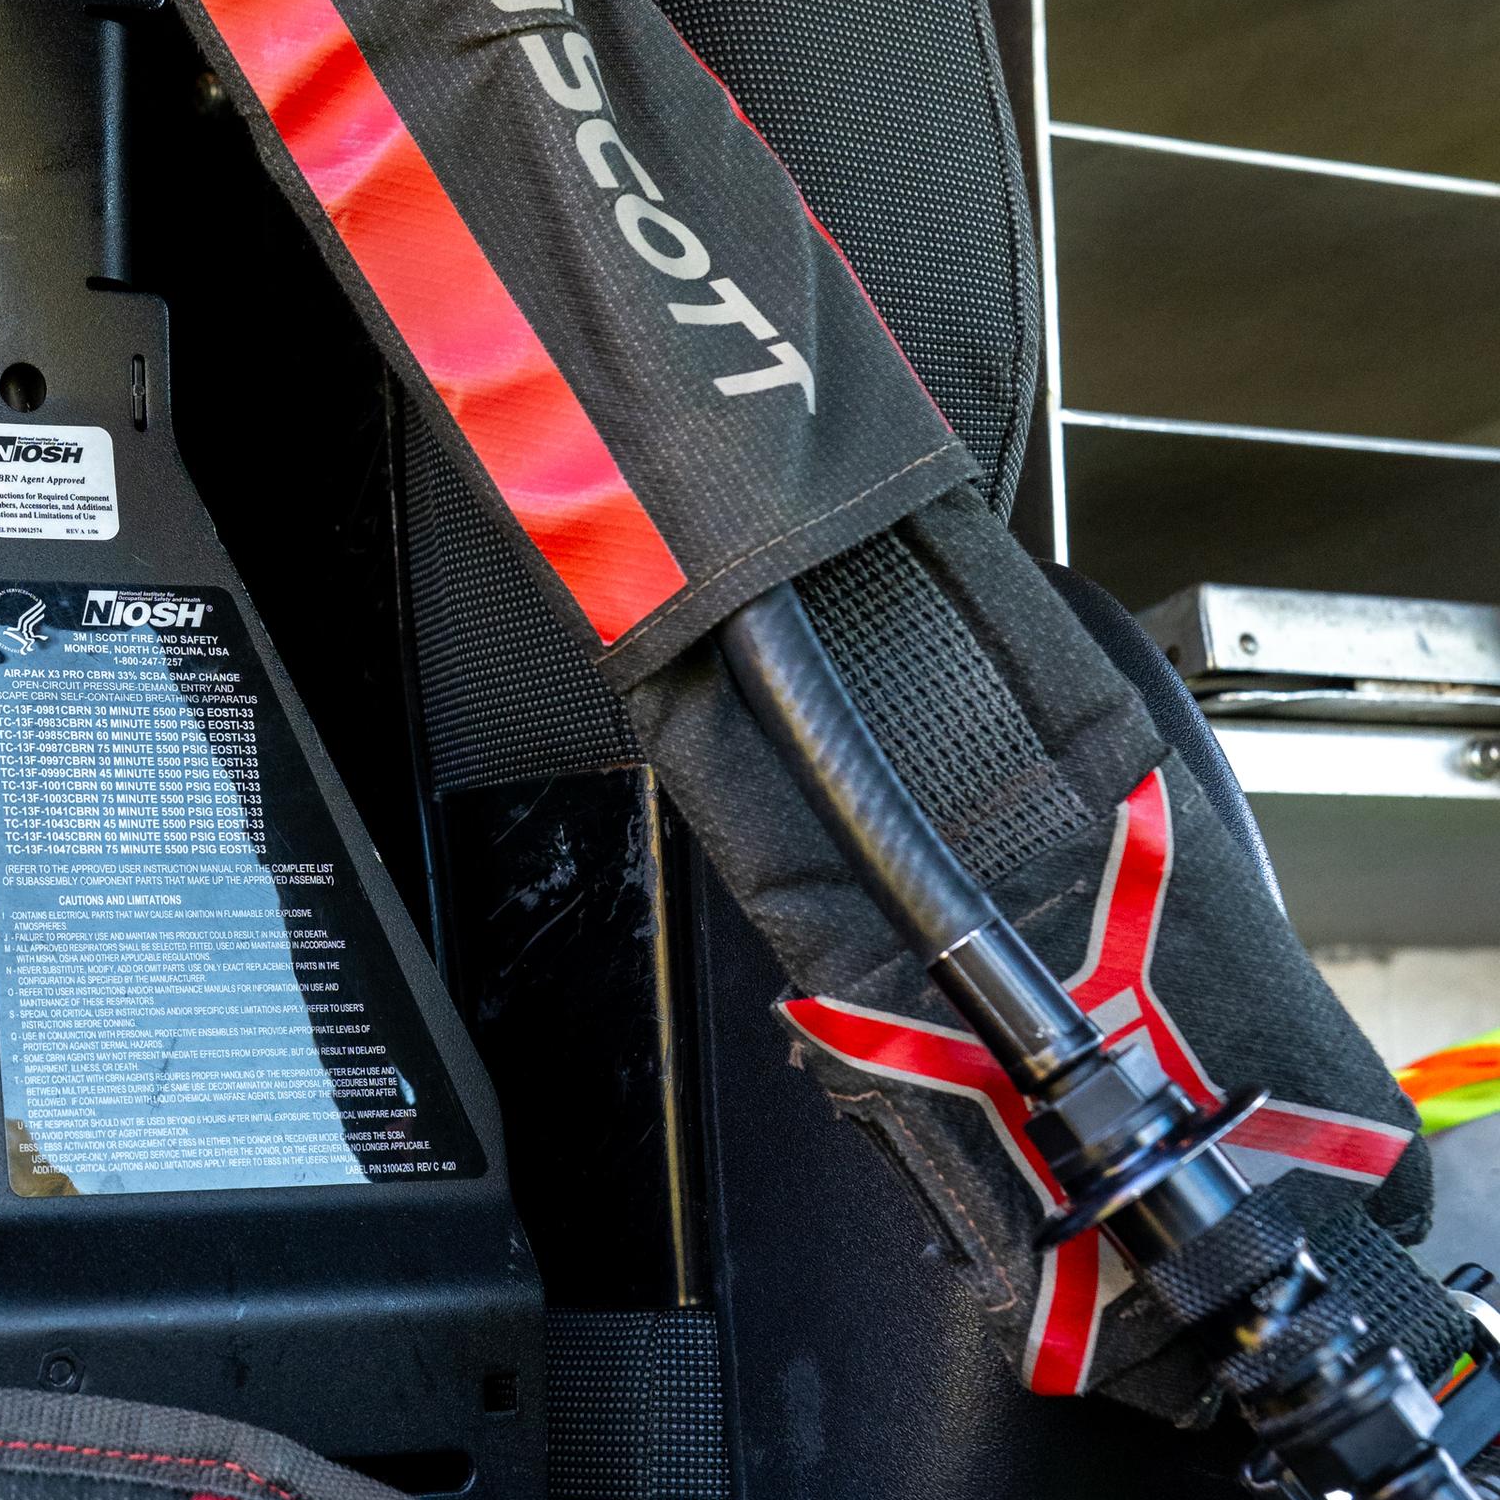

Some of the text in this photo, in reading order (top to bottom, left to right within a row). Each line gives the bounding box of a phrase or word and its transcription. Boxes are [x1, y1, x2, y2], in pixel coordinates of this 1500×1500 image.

[518, 29, 816, 414] SCOTT
[20, 475, 45, 485] Agent
[47, 476, 85, 485] Approved
[37, 492, 68, 501] Required
[69, 493, 109, 503] Component
[19, 502, 60, 511] Accessories,
[76, 503, 112, 511] Additional
[33, 511, 73, 519] Limitations
[82, 512, 96, 520] Use
[73, 632, 218, 644] 3M SCOTT FIRE AND SAFETY
[64, 644, 229, 656] MONROE, NORTH CAROLINA, USA
[113, 656, 182, 666] 1-800-247-7257
[3, 668, 240, 682] AIR-PAK X3 PRO CBRN 33% SCBA SNAP CHANGE
[11, 680, 234, 692] OPEN-CIRCUIT PRESSURE-DEMAND ENTRY AND
[30, 691, 58, 700] CBRN
[60, 692, 143, 701] SELF-CONTAINED
[144, 693, 199, 702] BREATHING
[201, 694, 257, 703] APPARATUS
[94, 706, 106, 715] 30
[109, 706, 150, 715] MINUTE
[152, 707, 176, 716] 5500
[179, 707, 204, 717] PSIG
[206, 707, 253, 717] EOSTI-33
[94, 718, 108, 727] 45
[110, 718, 151, 728] MINUTE
[154, 719, 177, 729] 5500
[180, 719, 205, 729] PSIG
[207, 720, 254, 729] EOSTI-33
[58, 894, 181, 905] CAUTIONS AND LIMITATIONS
